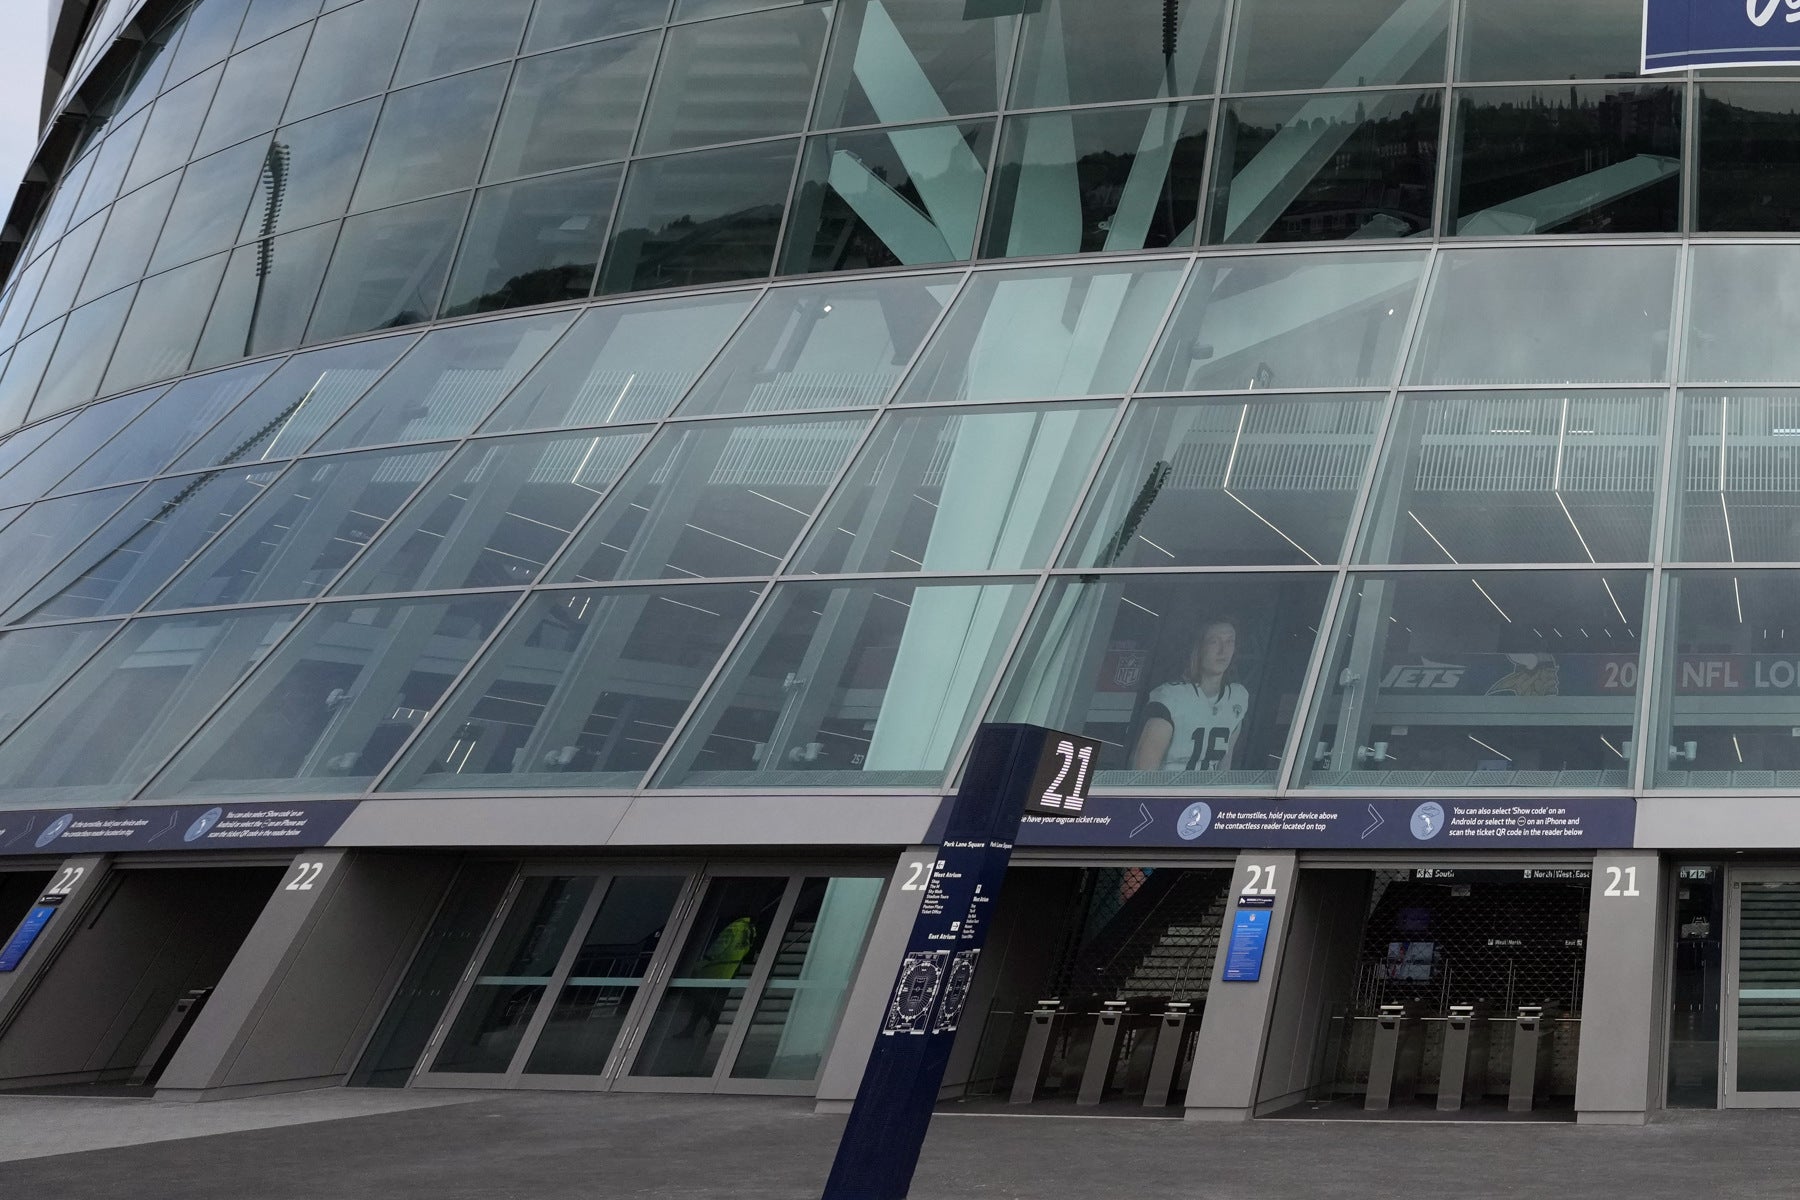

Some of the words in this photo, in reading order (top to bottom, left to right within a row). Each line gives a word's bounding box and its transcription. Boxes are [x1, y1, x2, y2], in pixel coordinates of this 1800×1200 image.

[1603, 661, 1637, 688] 20
[1682, 660, 1739, 688] NFL
[1040, 740, 1093, 812] 21
[1093, 816, 1111, 825] ready
[1214, 822, 1224, 830] the
[1225, 822, 1260, 830] contactless
[1261, 822, 1281, 830] reader
[1282, 822, 1305, 830] located
[1315, 823, 1327, 832] top
[1237, 812, 1267, 820] turnstiles,
[1283, 813, 1297, 821] your
[1545, 817, 1566, 825] iPhone
[1567, 817, 1580, 825] and
[967, 841, 985, 849] Square
[1465, 828, 1475, 836] the
[1476, 828, 1495, 836] ticket
[1496, 828, 1506, 837] QR
[1507, 828, 1522, 836] code
[1523, 828, 1529, 836] in
[1530, 828, 1541, 836] the
[1542, 828, 1563, 836] reader
[1564, 828, 1583, 836] below
[49, 866, 85, 895] 22
[285, 862, 324, 891] 22
[901, 862, 935, 891] 21
[1241, 865, 1277, 895] 21
[1604, 866, 1640, 897] 21
